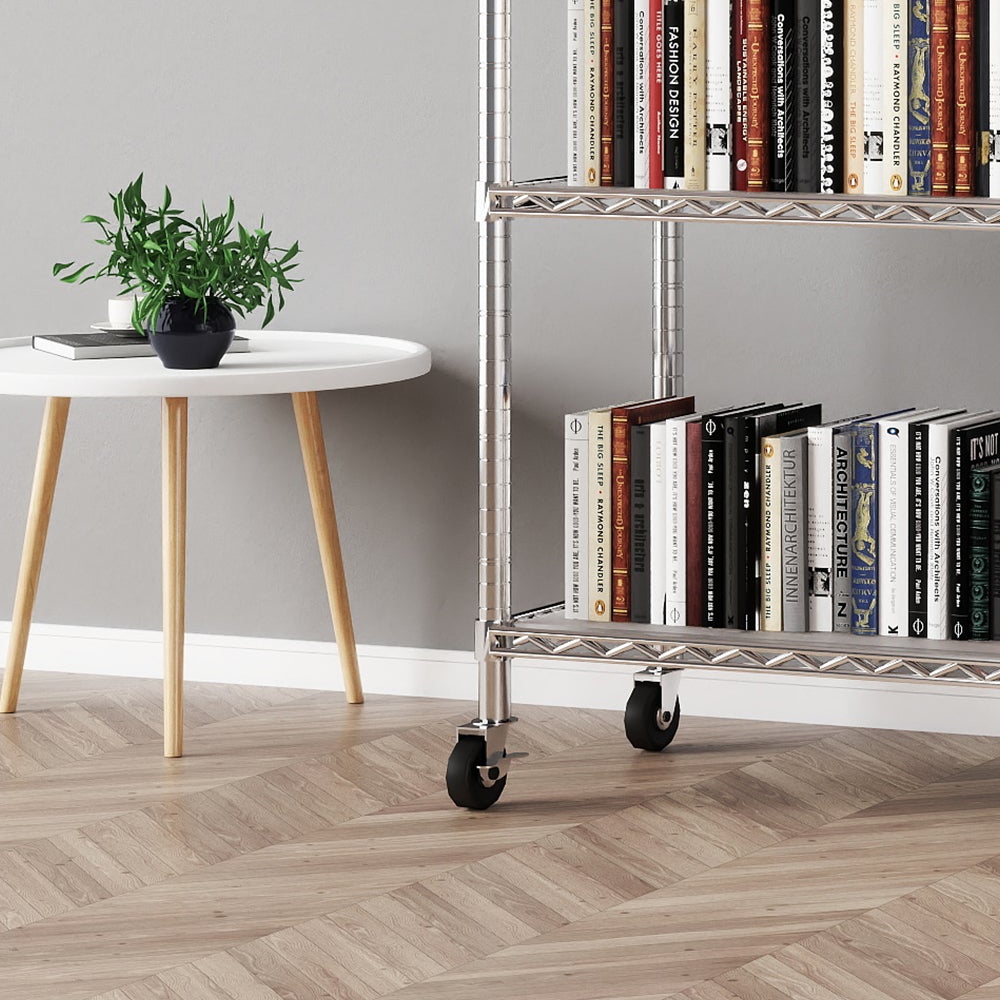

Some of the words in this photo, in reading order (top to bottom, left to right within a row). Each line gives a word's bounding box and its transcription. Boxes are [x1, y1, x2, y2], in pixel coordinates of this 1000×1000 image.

[669, 26, 679, 84] FASHION
[751, 43, 759, 94] UNEXPECTED
[936, 46, 944, 99] UNEXPECTED
[957, 52, 966, 101] UNEXPECTED
[669, 90, 679, 138] DESIGN
[751, 94, 759, 128] JOURNEY
[936, 98, 944, 132] JOURNEY
[957, 101, 966, 136] JOURNEY
[970, 436, 984, 462] IT'S
[985, 432, 999, 457] NOT
[615, 476, 625, 524] UNEXPECTED
[836, 448, 847, 577] ARCHITECTURE
[615, 525, 625, 559] JOURNEY
[784, 450, 798, 602] INNENARCHITEKTUR
